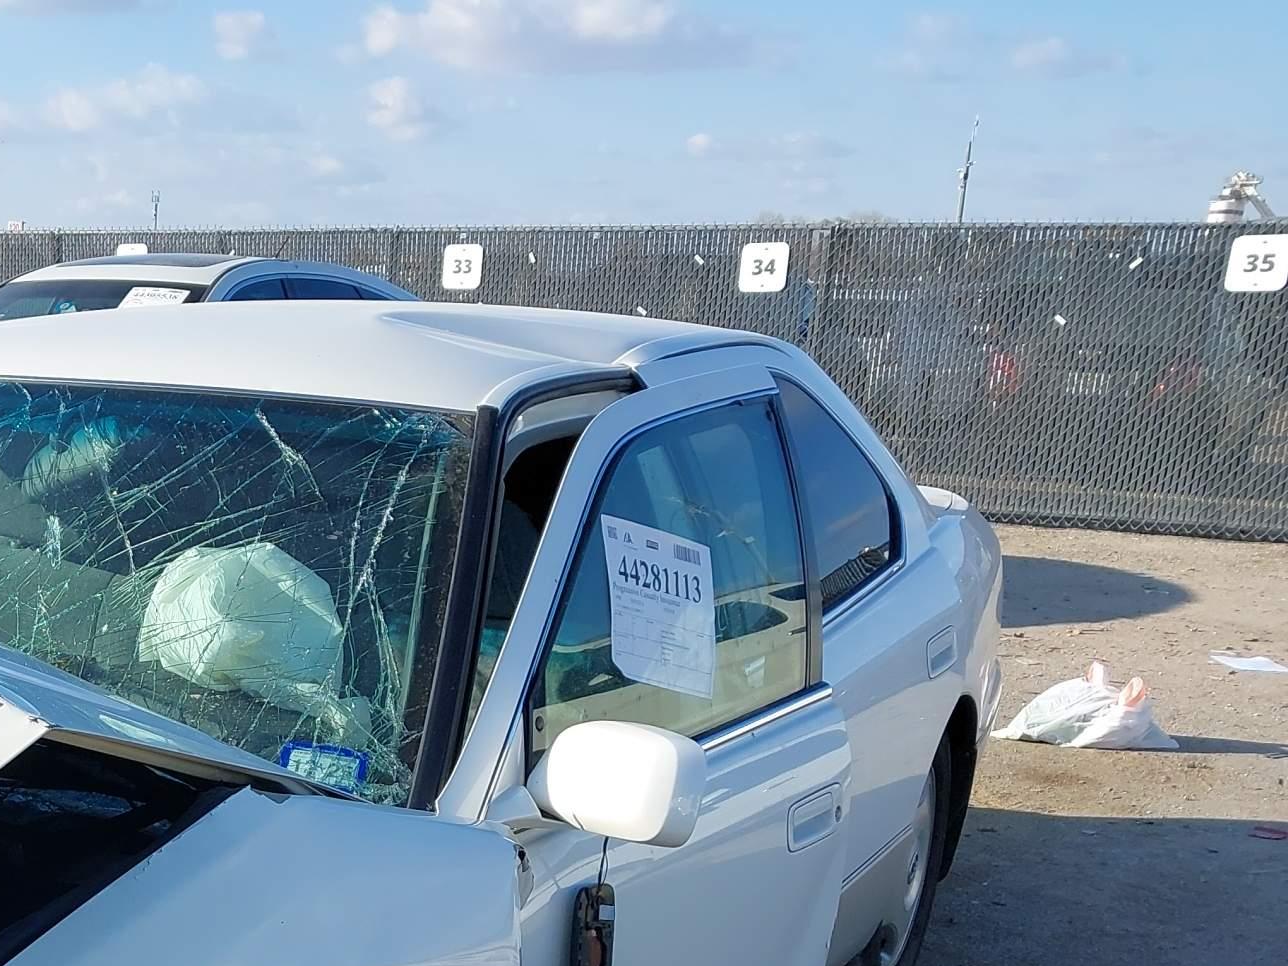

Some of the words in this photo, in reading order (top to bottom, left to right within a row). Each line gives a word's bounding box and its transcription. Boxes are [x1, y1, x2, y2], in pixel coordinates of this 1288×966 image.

[452, 259, 472, 274] 33
[752, 258, 776, 276] 34
[1243, 254, 1276, 273] 35
[618, 555, 702, 604] 44281113
